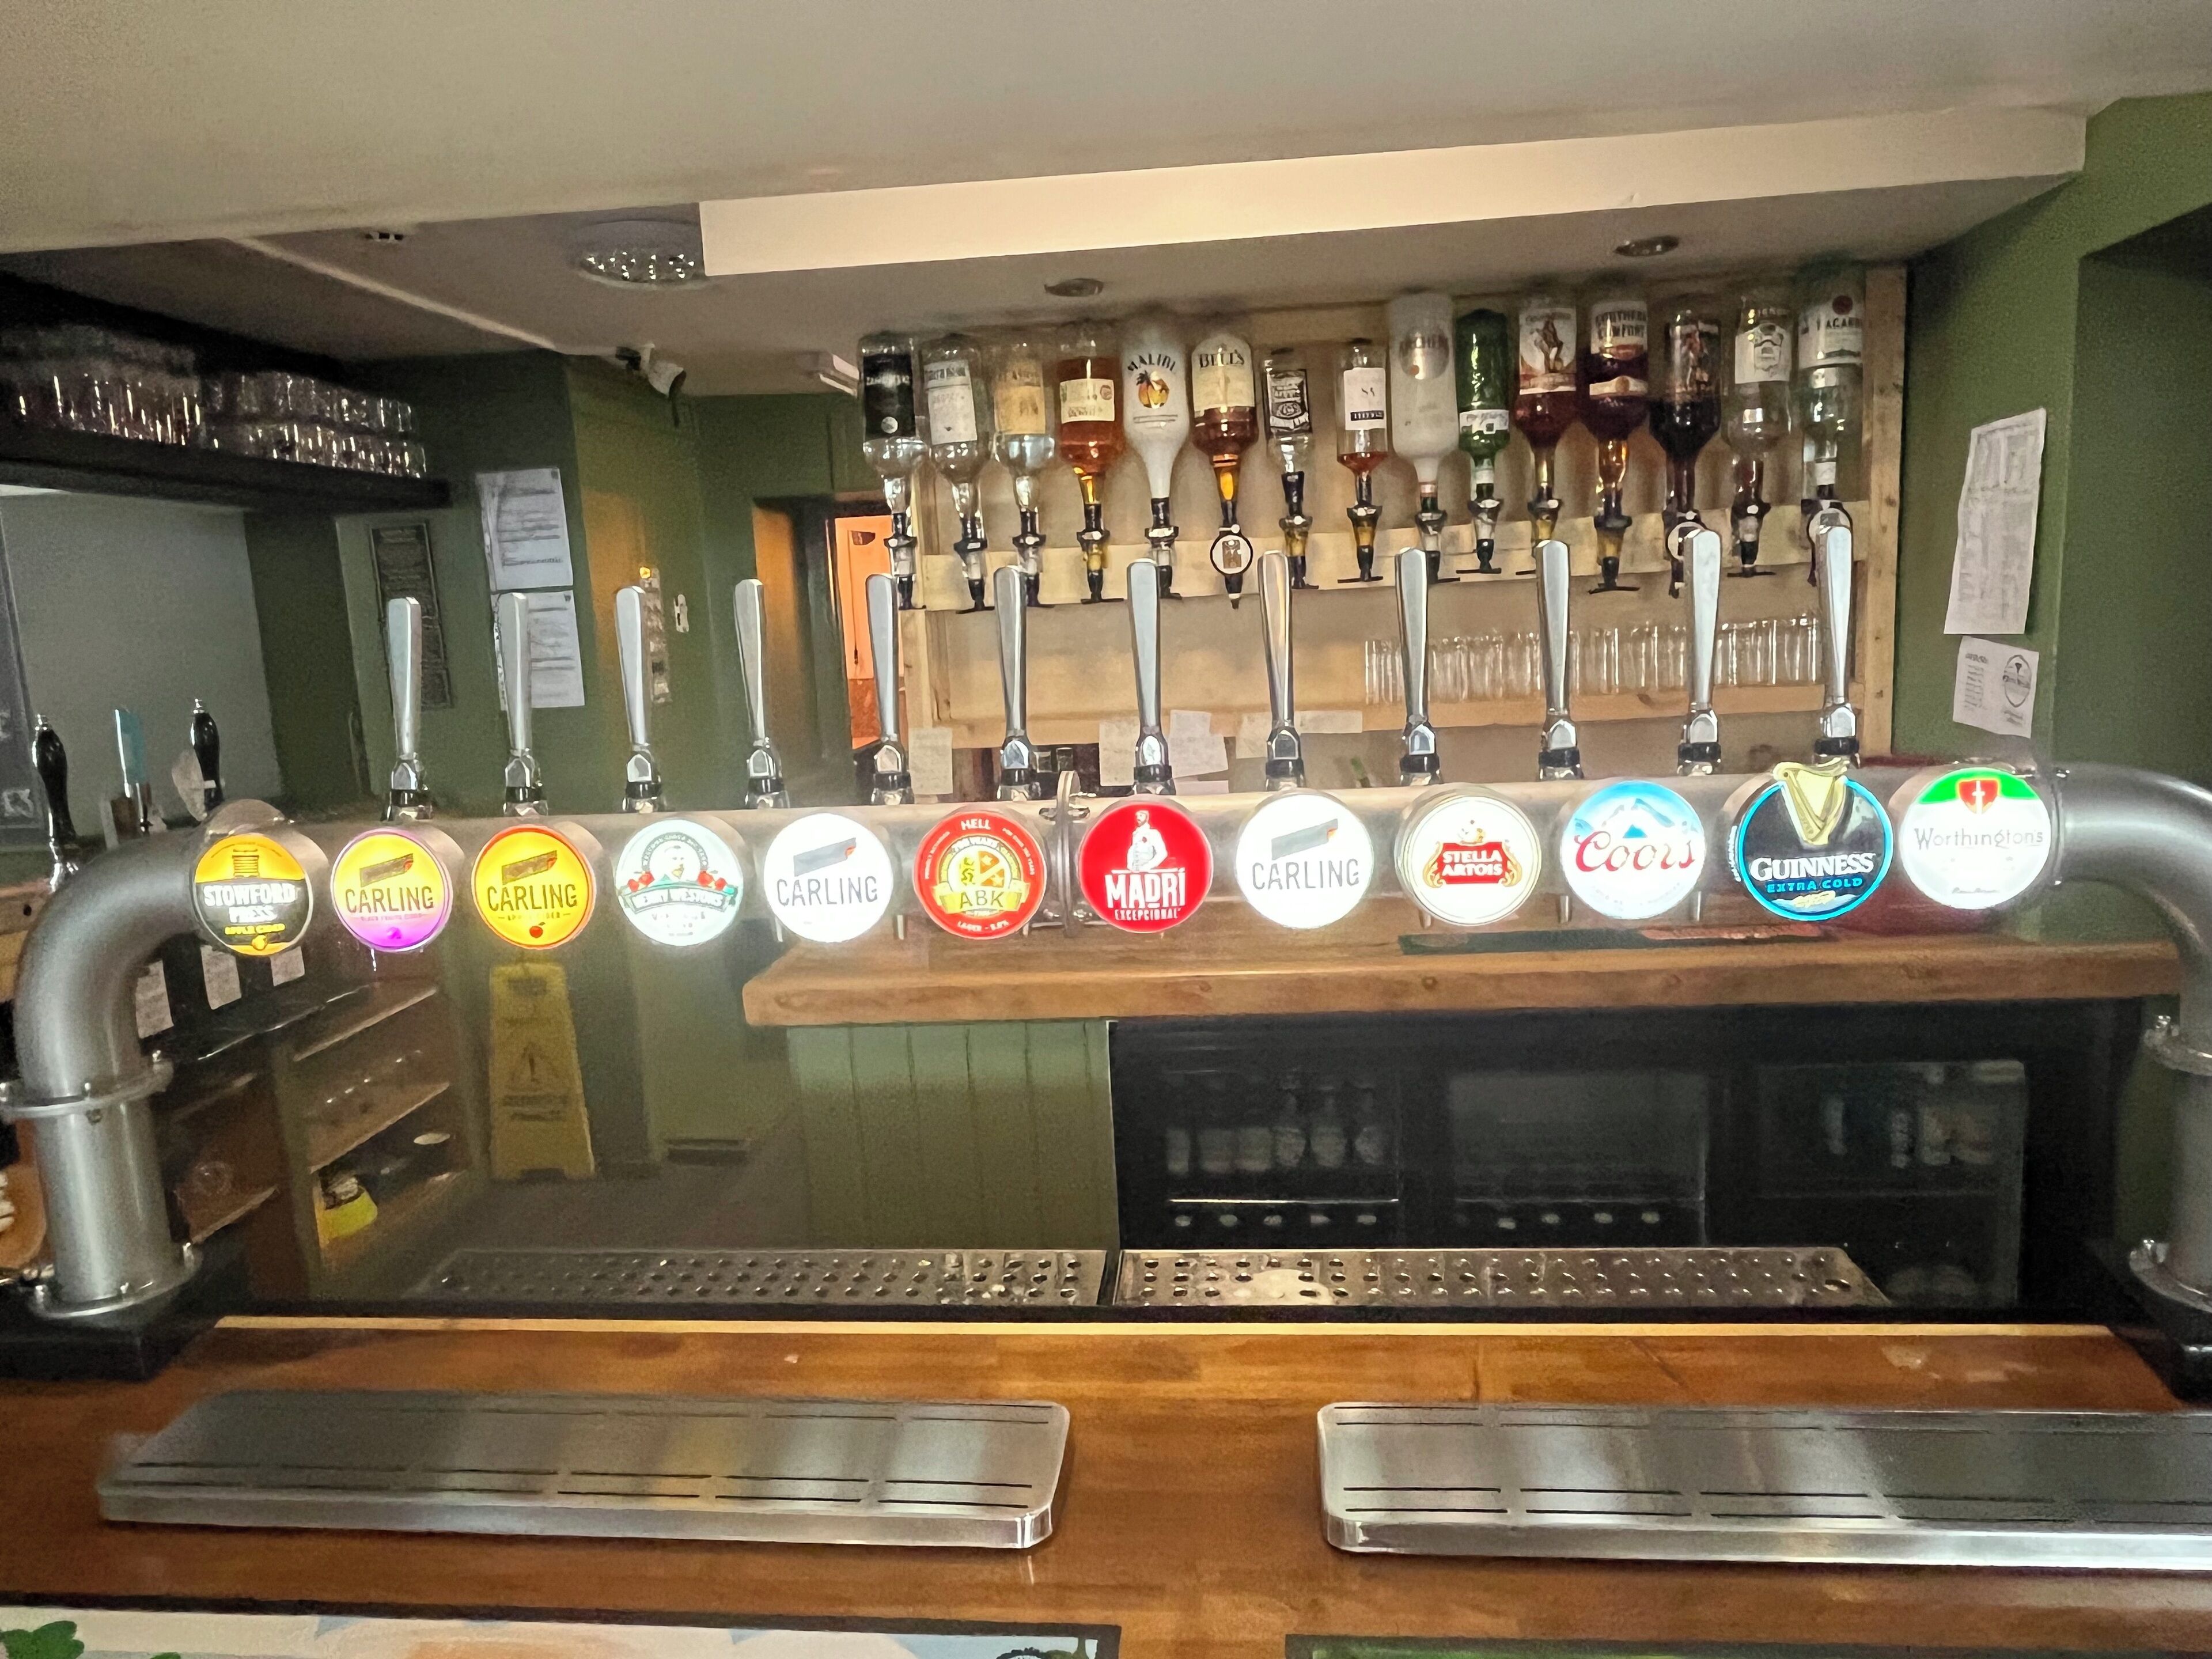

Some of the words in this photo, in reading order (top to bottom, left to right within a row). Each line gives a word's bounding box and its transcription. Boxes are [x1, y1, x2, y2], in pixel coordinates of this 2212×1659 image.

[961, 819, 991, 830] HELL
[1914, 828, 2043, 850] Worthington's
[1442, 850, 1503, 863] STELLA
[1574, 831, 1695, 872] Coors
[1252, 858, 1360, 890] CARLING
[1441, 863, 1503, 876] ARTOIS
[1749, 853, 1876, 881] GUINNESS
[203, 883, 296, 906] STOWFORD
[777, 876, 877, 907] CARLING
[1767, 881, 1817, 893] EXTRA
[1821, 878, 1863, 889] COLD
[345, 886, 434, 913] CARLING
[487, 884, 578, 911] CARLING
[960, 890, 1003, 908] ABK
[1114, 908, 1178, 921] EXCEPCIONAL
